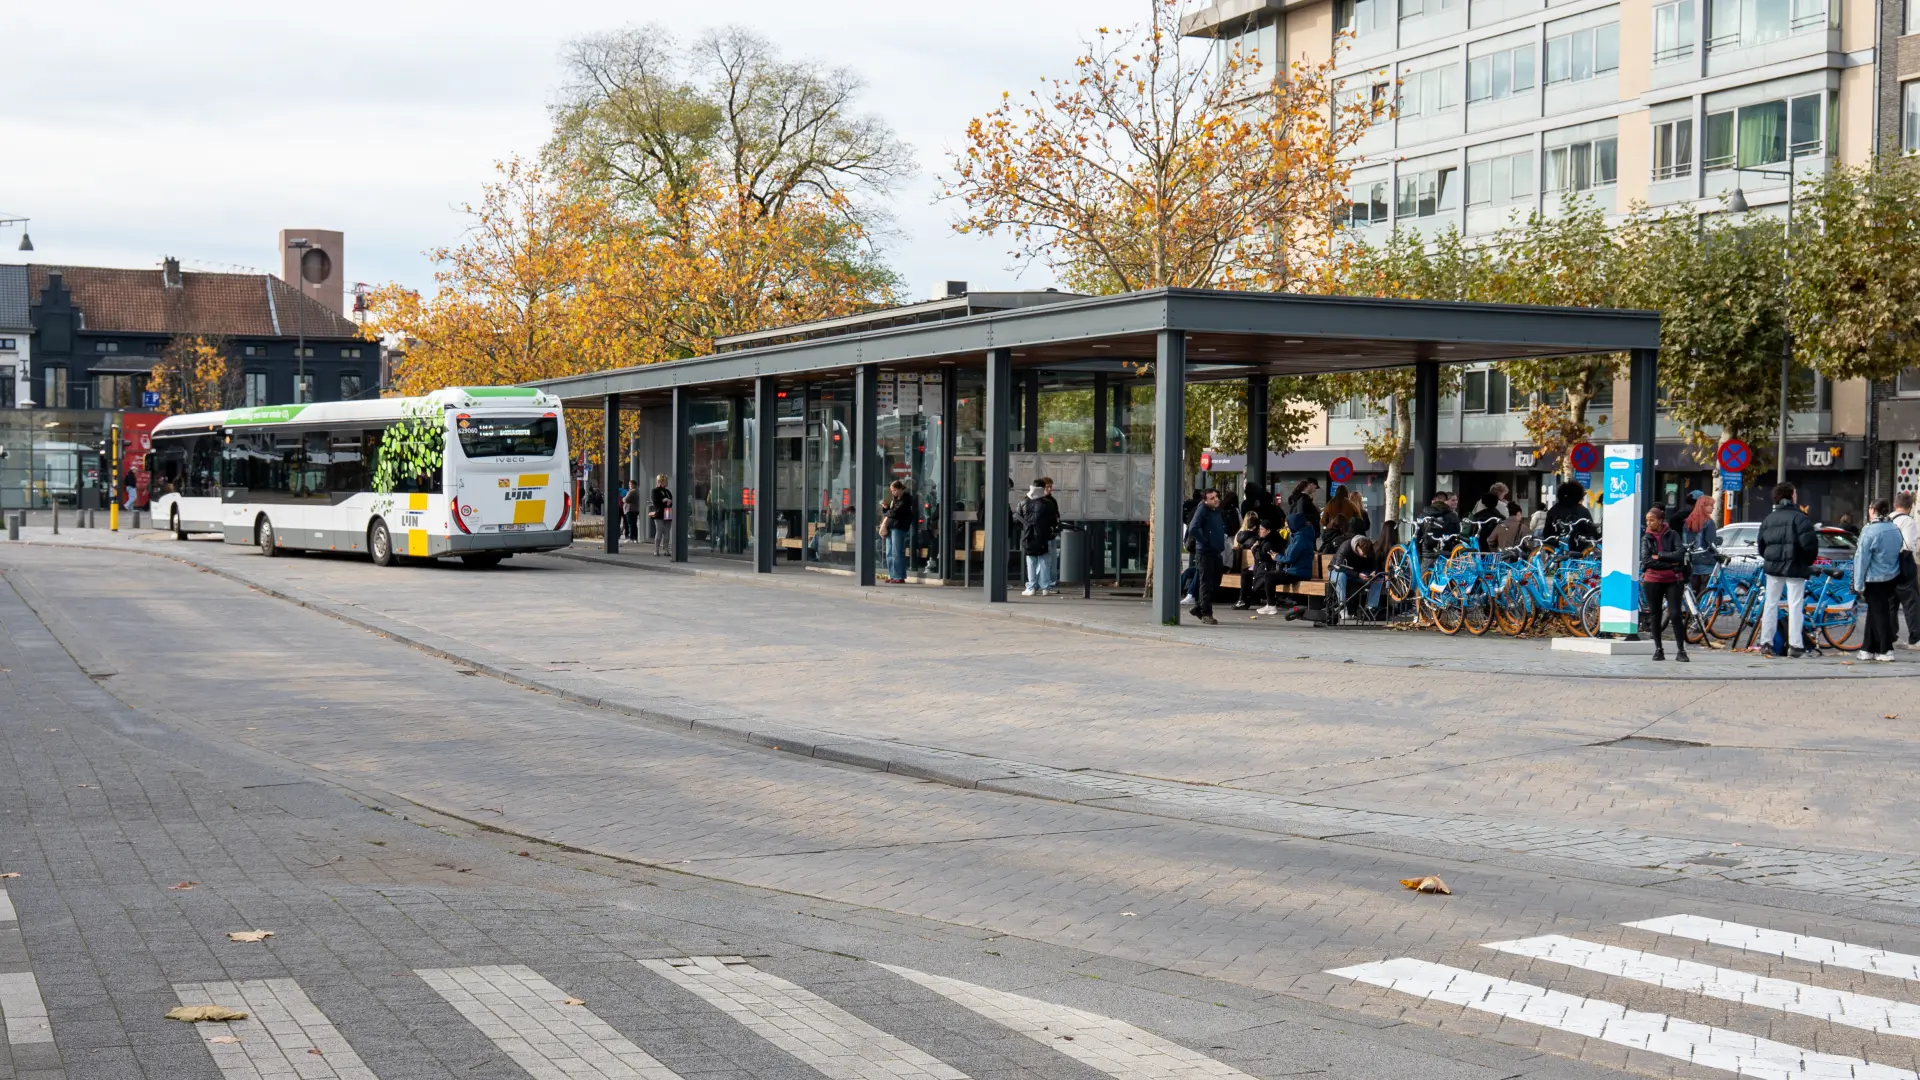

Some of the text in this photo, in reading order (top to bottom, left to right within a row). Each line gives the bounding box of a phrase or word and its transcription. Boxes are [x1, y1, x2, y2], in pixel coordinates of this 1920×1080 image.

[152, 392, 159, 403] P
[1515, 450, 1535, 467] itzu
[1806, 447, 1832, 466] itzu
